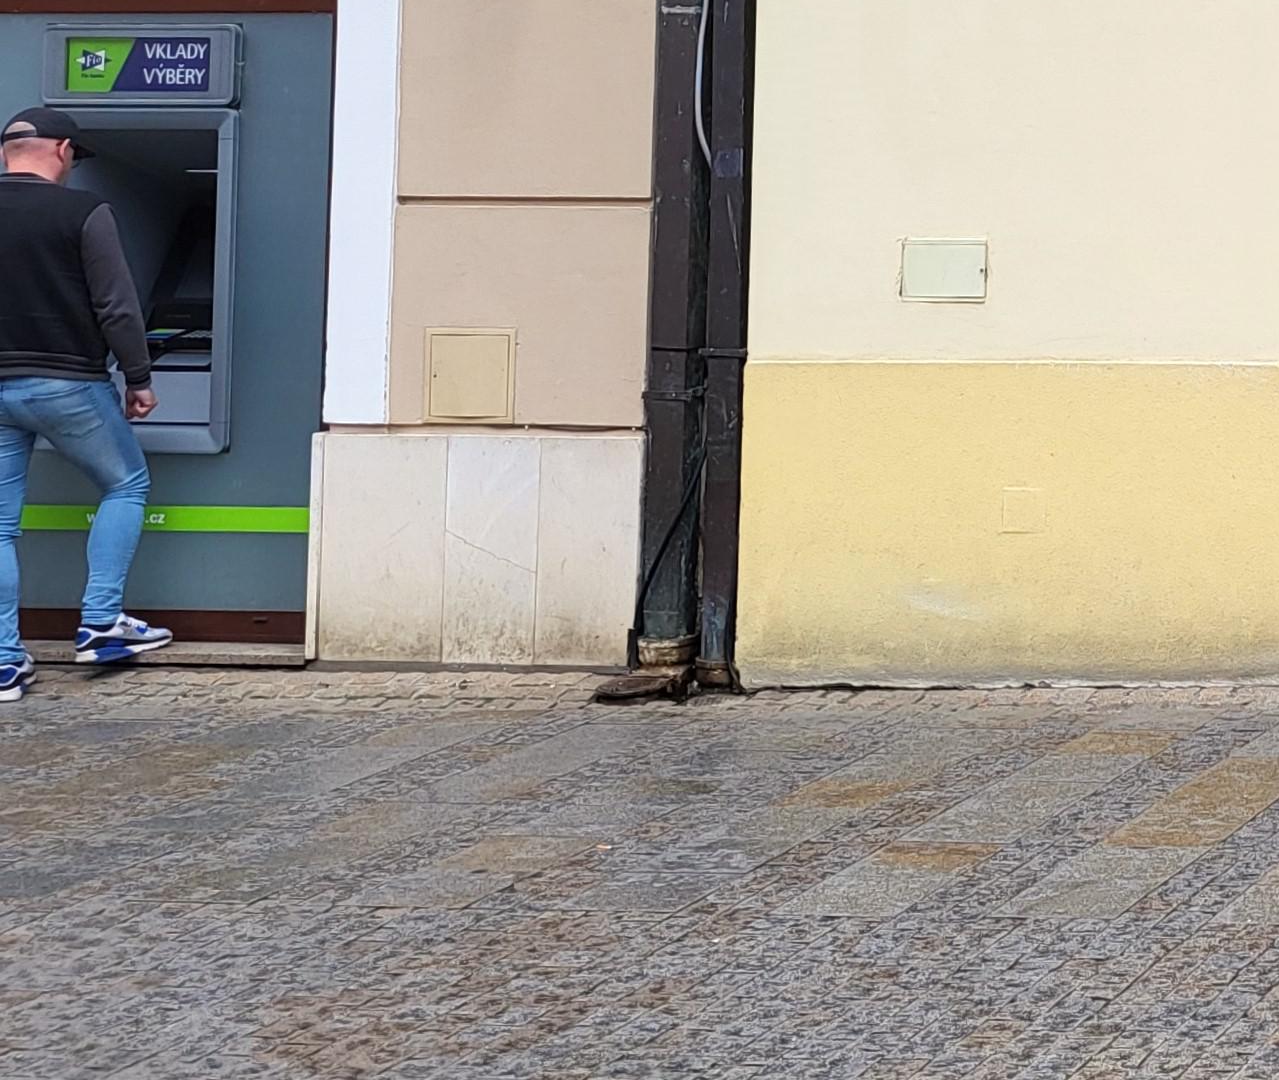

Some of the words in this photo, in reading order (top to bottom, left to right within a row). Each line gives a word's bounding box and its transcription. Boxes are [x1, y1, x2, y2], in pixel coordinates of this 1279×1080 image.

[144, 43, 208, 59] VKLADY
[86, 53, 102, 68] Fio
[143, 63, 206, 85] VÝBĚRY
